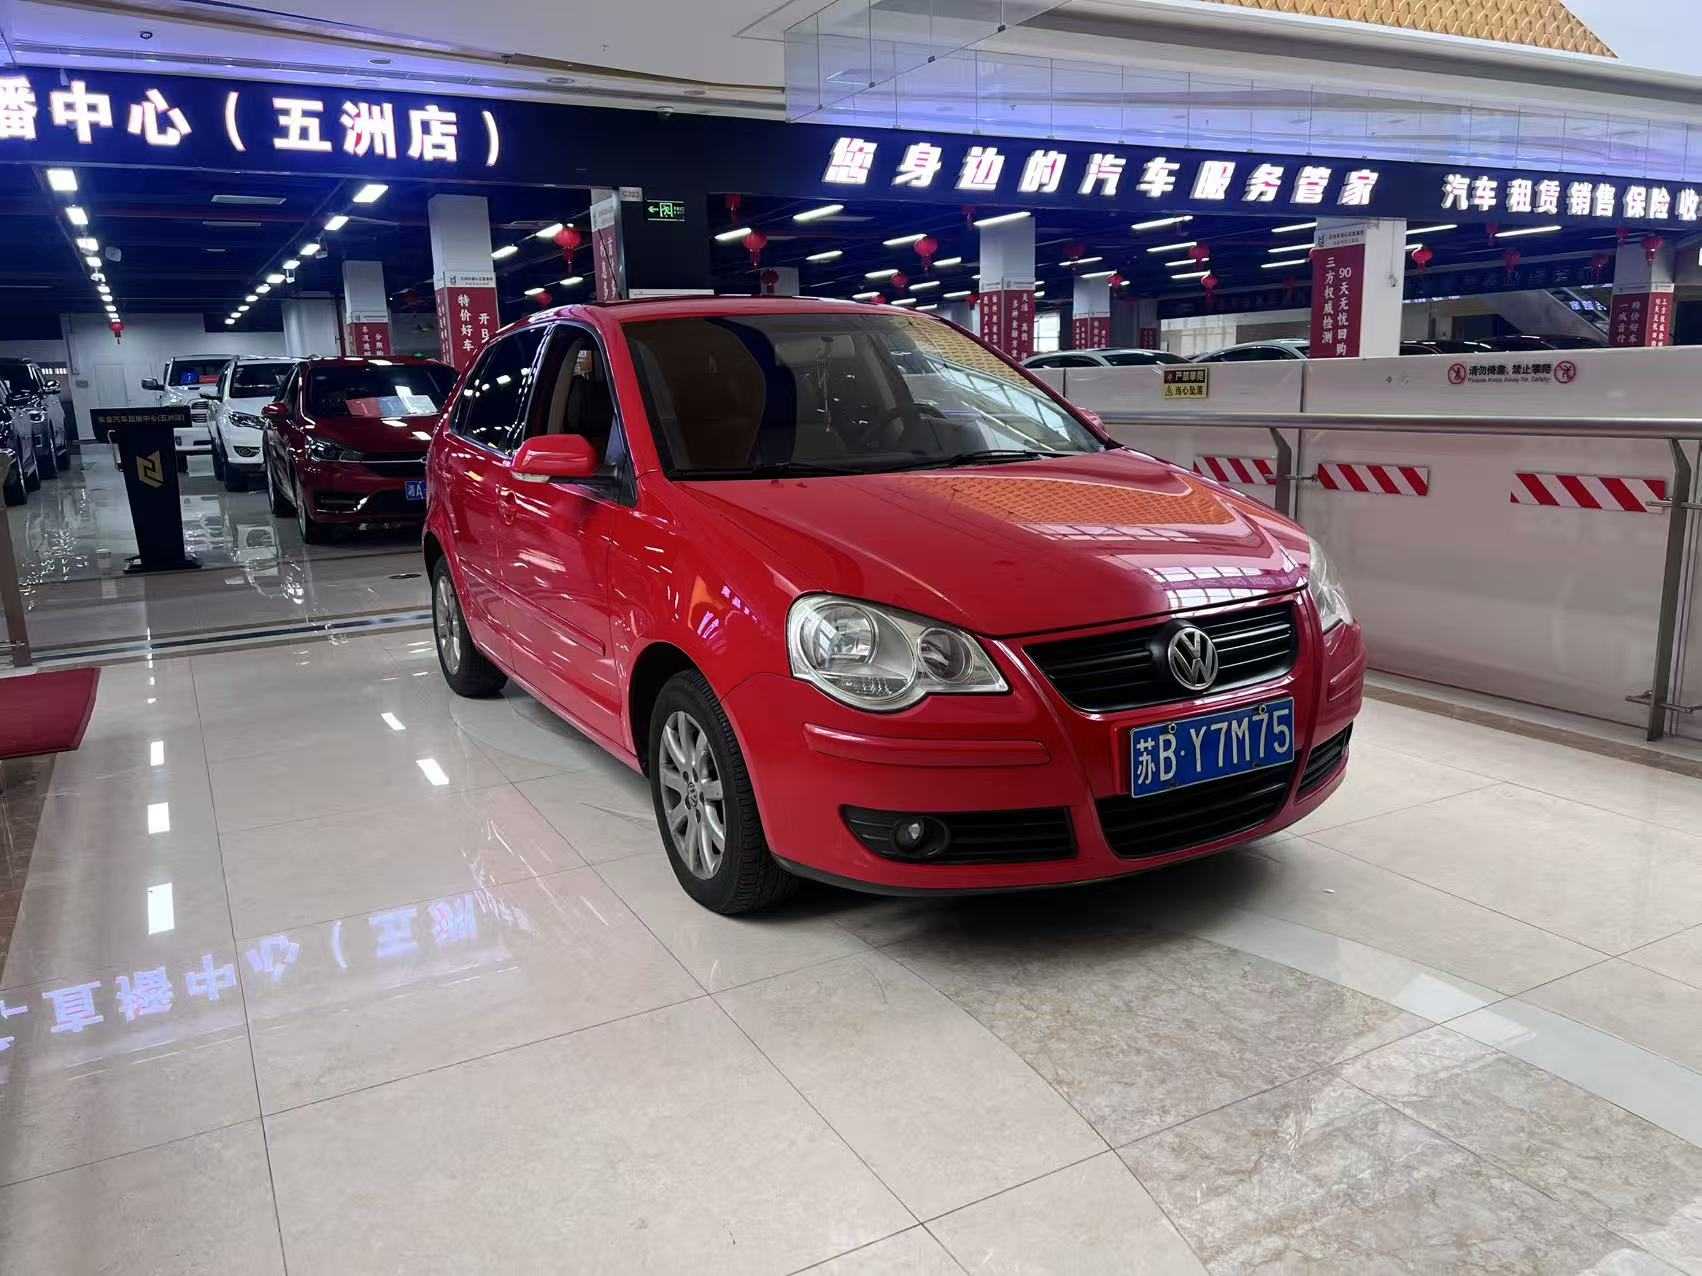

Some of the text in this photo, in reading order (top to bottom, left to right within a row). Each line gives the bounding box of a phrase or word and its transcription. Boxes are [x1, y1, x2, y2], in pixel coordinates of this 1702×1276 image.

[821, 137, 1379, 206] 您身边的汽车服务管家
[457, 294, 475, 352] 特价好车
